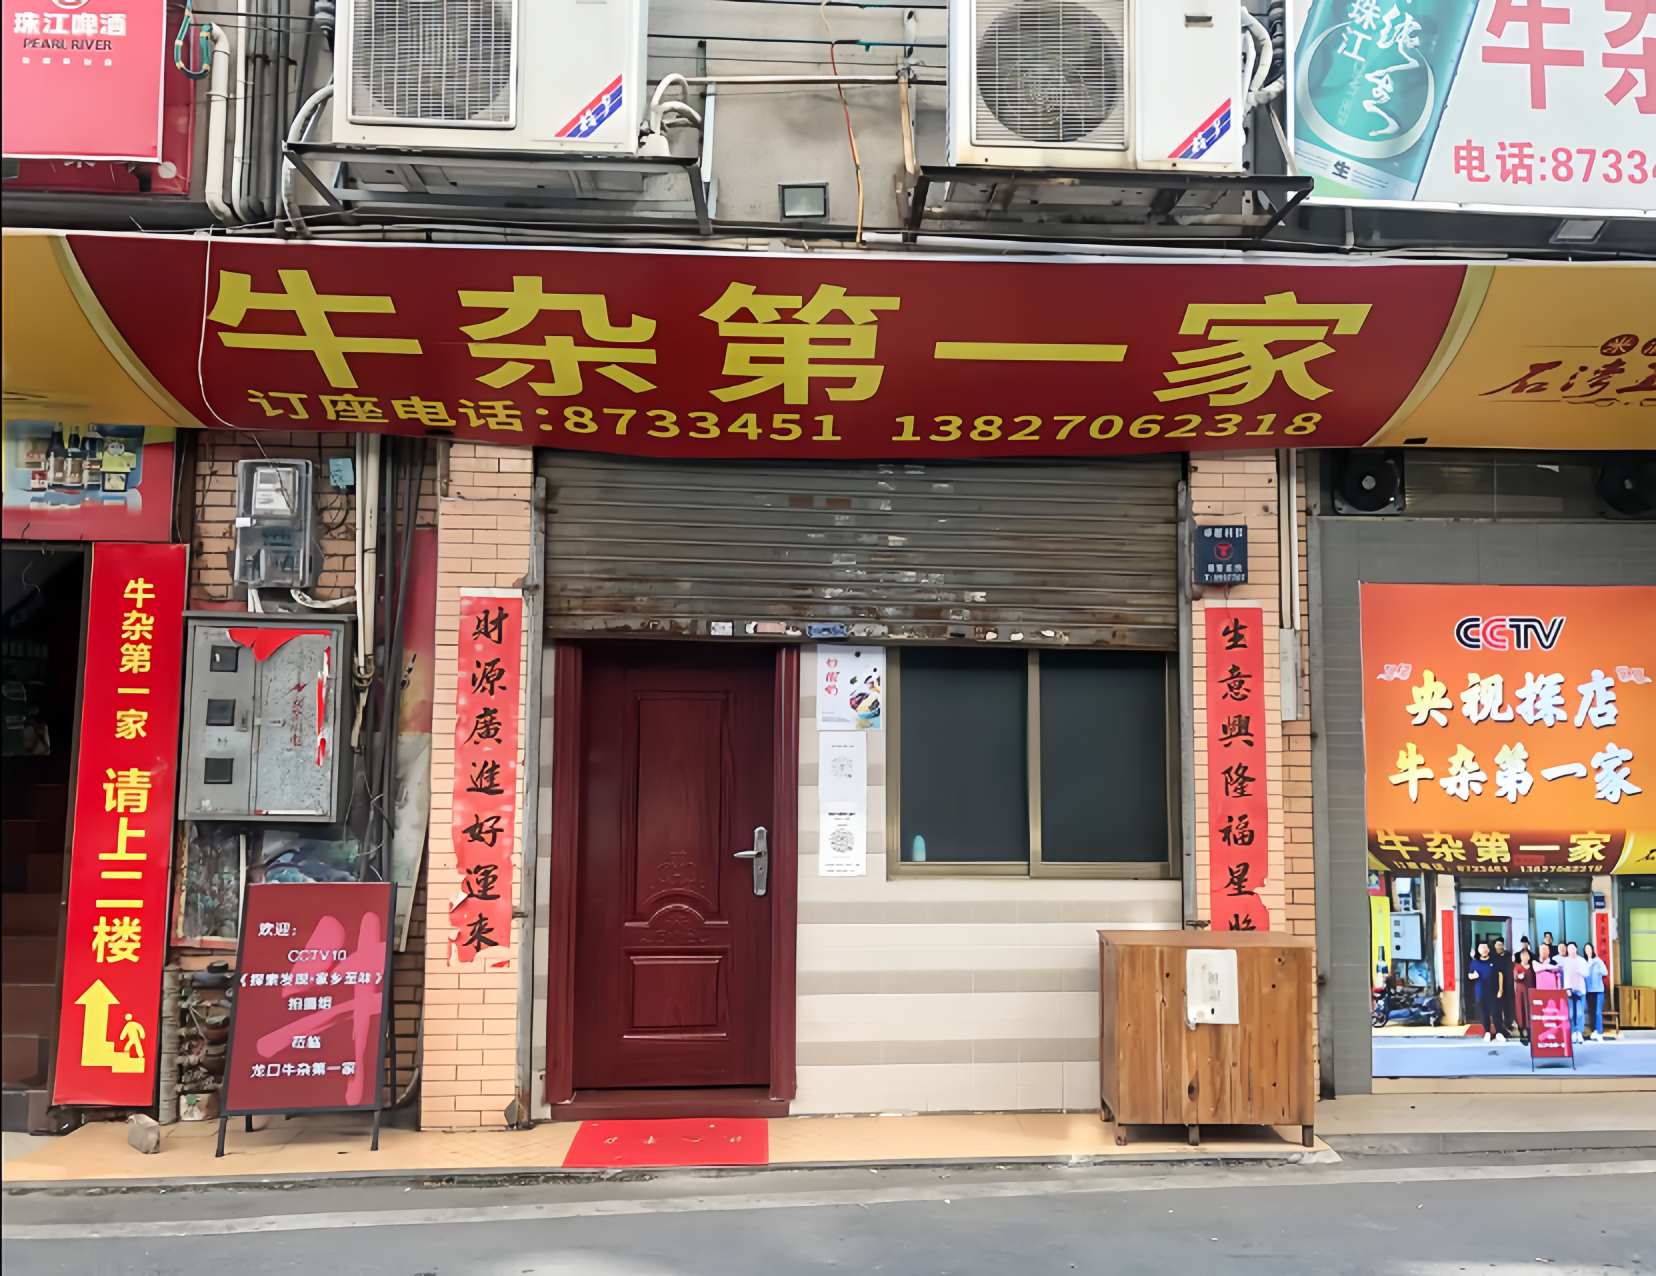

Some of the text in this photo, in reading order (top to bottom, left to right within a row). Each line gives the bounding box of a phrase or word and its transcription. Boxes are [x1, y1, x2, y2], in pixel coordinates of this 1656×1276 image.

[13, 11, 127, 37] 珠江啤酒
[23, 38, 112, 51] PEARL RIVER
[1454, 138, 1656, 185] 电话:8733
[207, 267, 1373, 408] 牛杂第一家
[891, 412, 1323, 441] 13827062318
[1454, 615, 1567, 650] CCTV
[1405, 669, 1619, 729] 央视探店
[90, 576, 156, 965] 牛杂第一家 请上二楼
[1388, 742, 1643, 804] 牛杂第一家
[1376, 829, 1612, 863] 牛杂第一家
